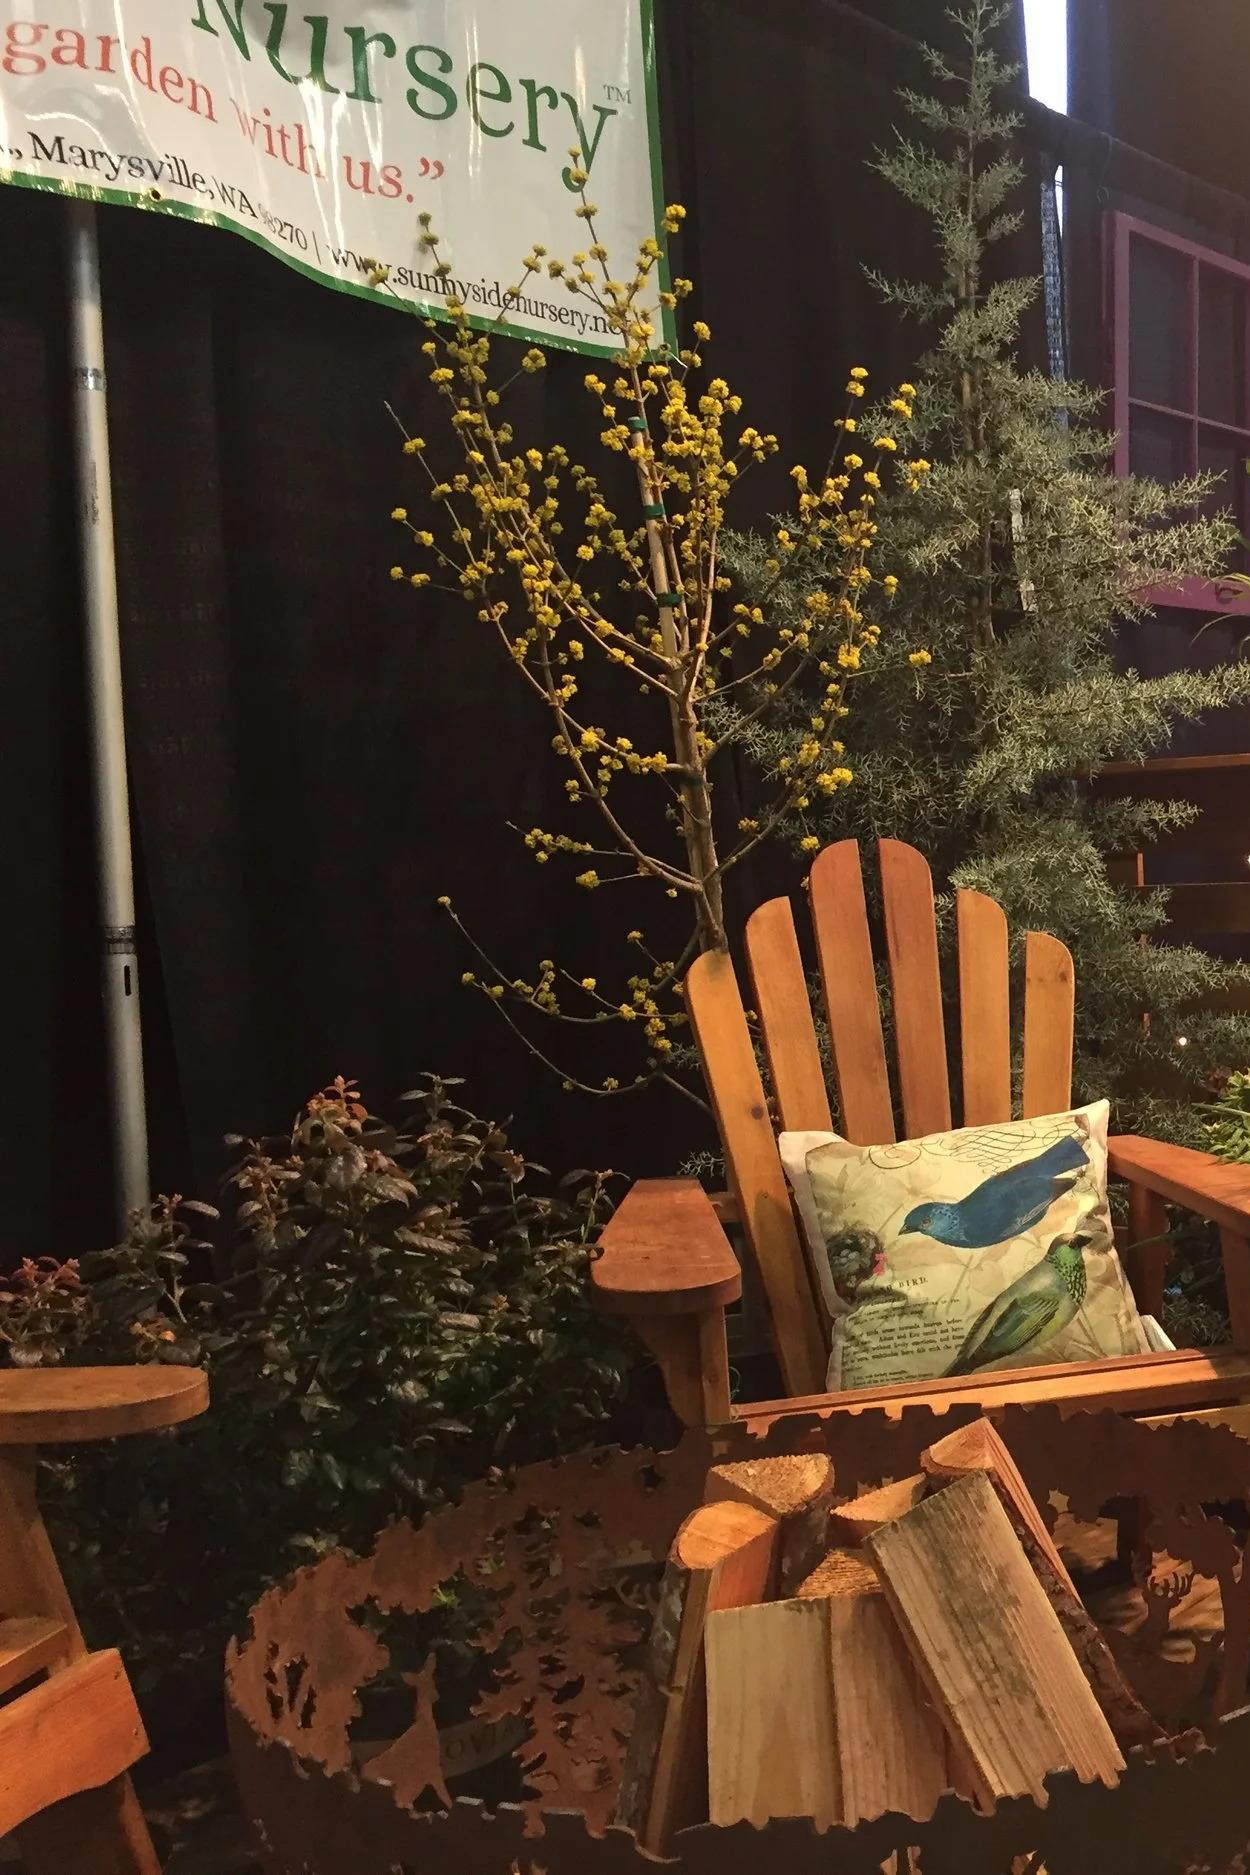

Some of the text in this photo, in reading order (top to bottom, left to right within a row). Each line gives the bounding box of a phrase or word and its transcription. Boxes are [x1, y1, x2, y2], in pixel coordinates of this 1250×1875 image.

[2, 22, 218, 124] garden
[229, 97, 328, 180] with
[603, 84, 632, 105] TM
[27, 131, 631, 335] Marysville, WA 98270 ww.sunnysidenursery.n
